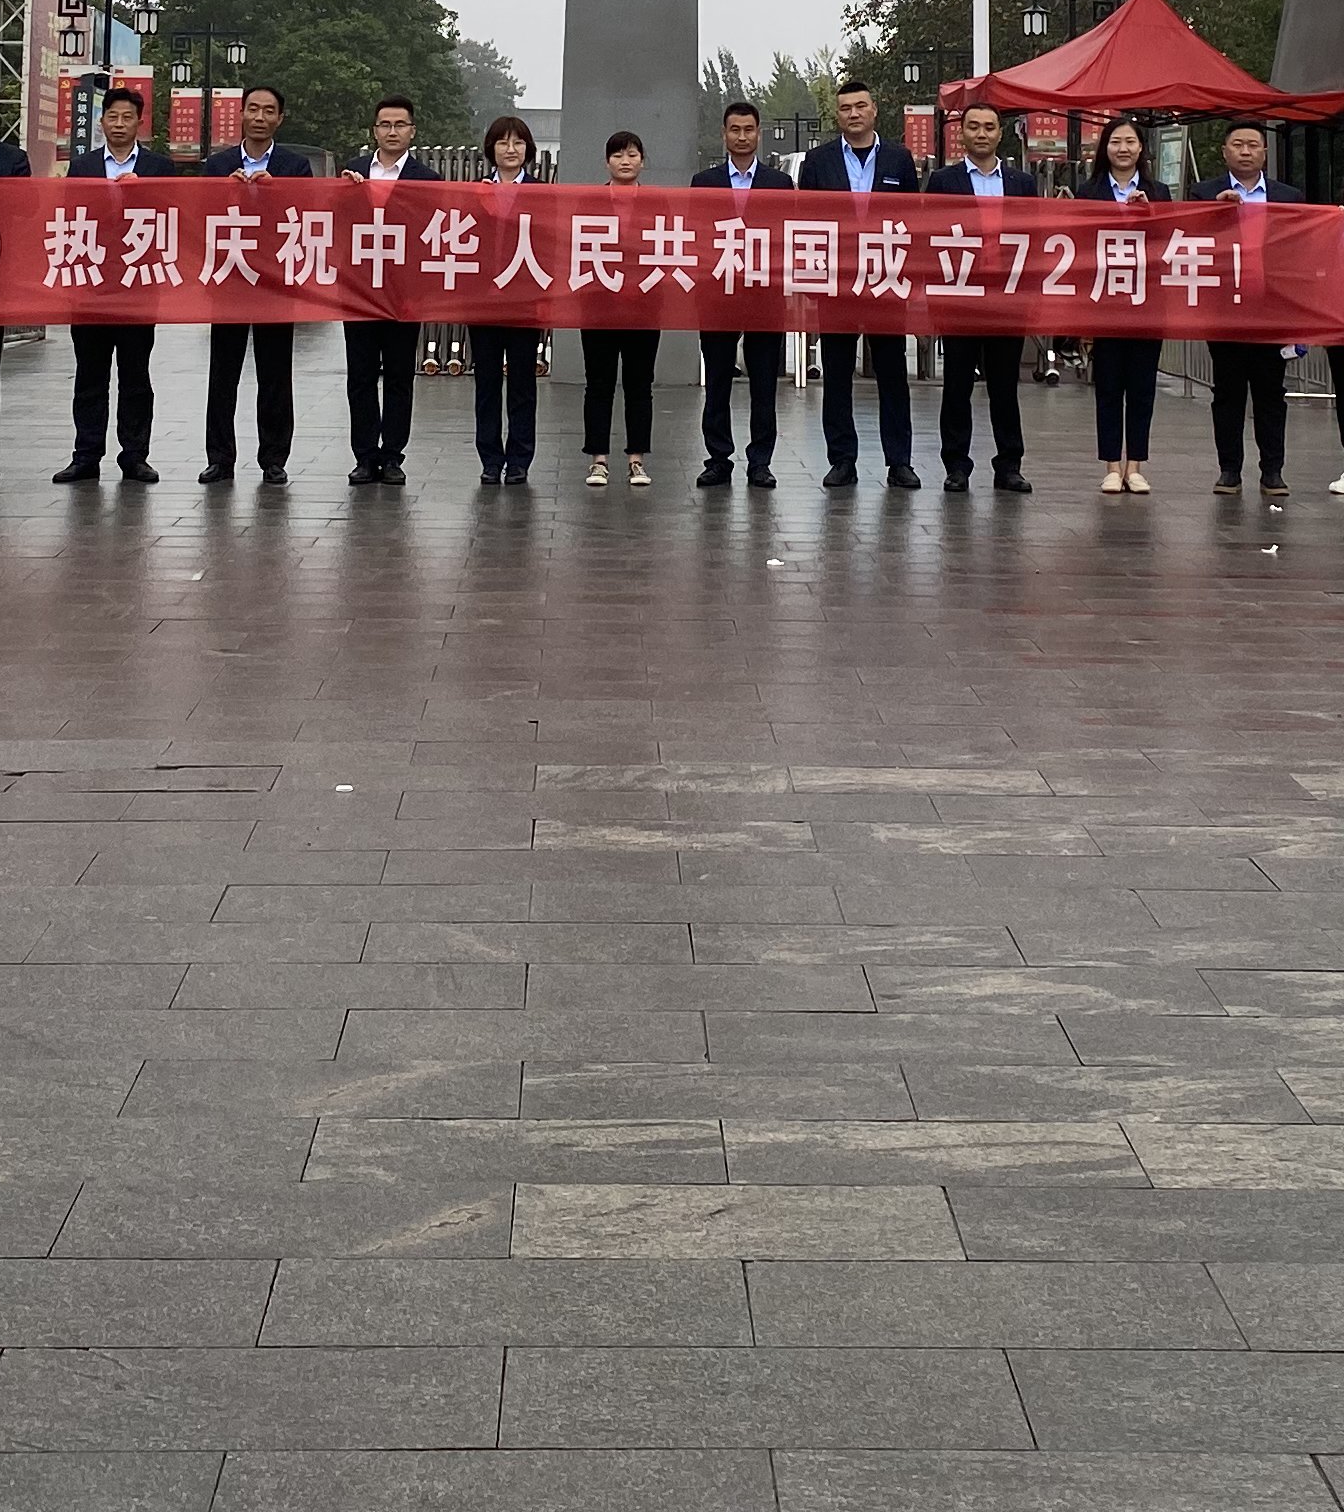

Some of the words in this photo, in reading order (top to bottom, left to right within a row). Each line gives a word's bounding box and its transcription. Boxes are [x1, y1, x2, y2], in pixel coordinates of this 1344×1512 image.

[76, 91, 88, 139] 垃圾分类
[42, 205, 1242, 307] 热烈庆祝中华人民共和国成立72周年!
